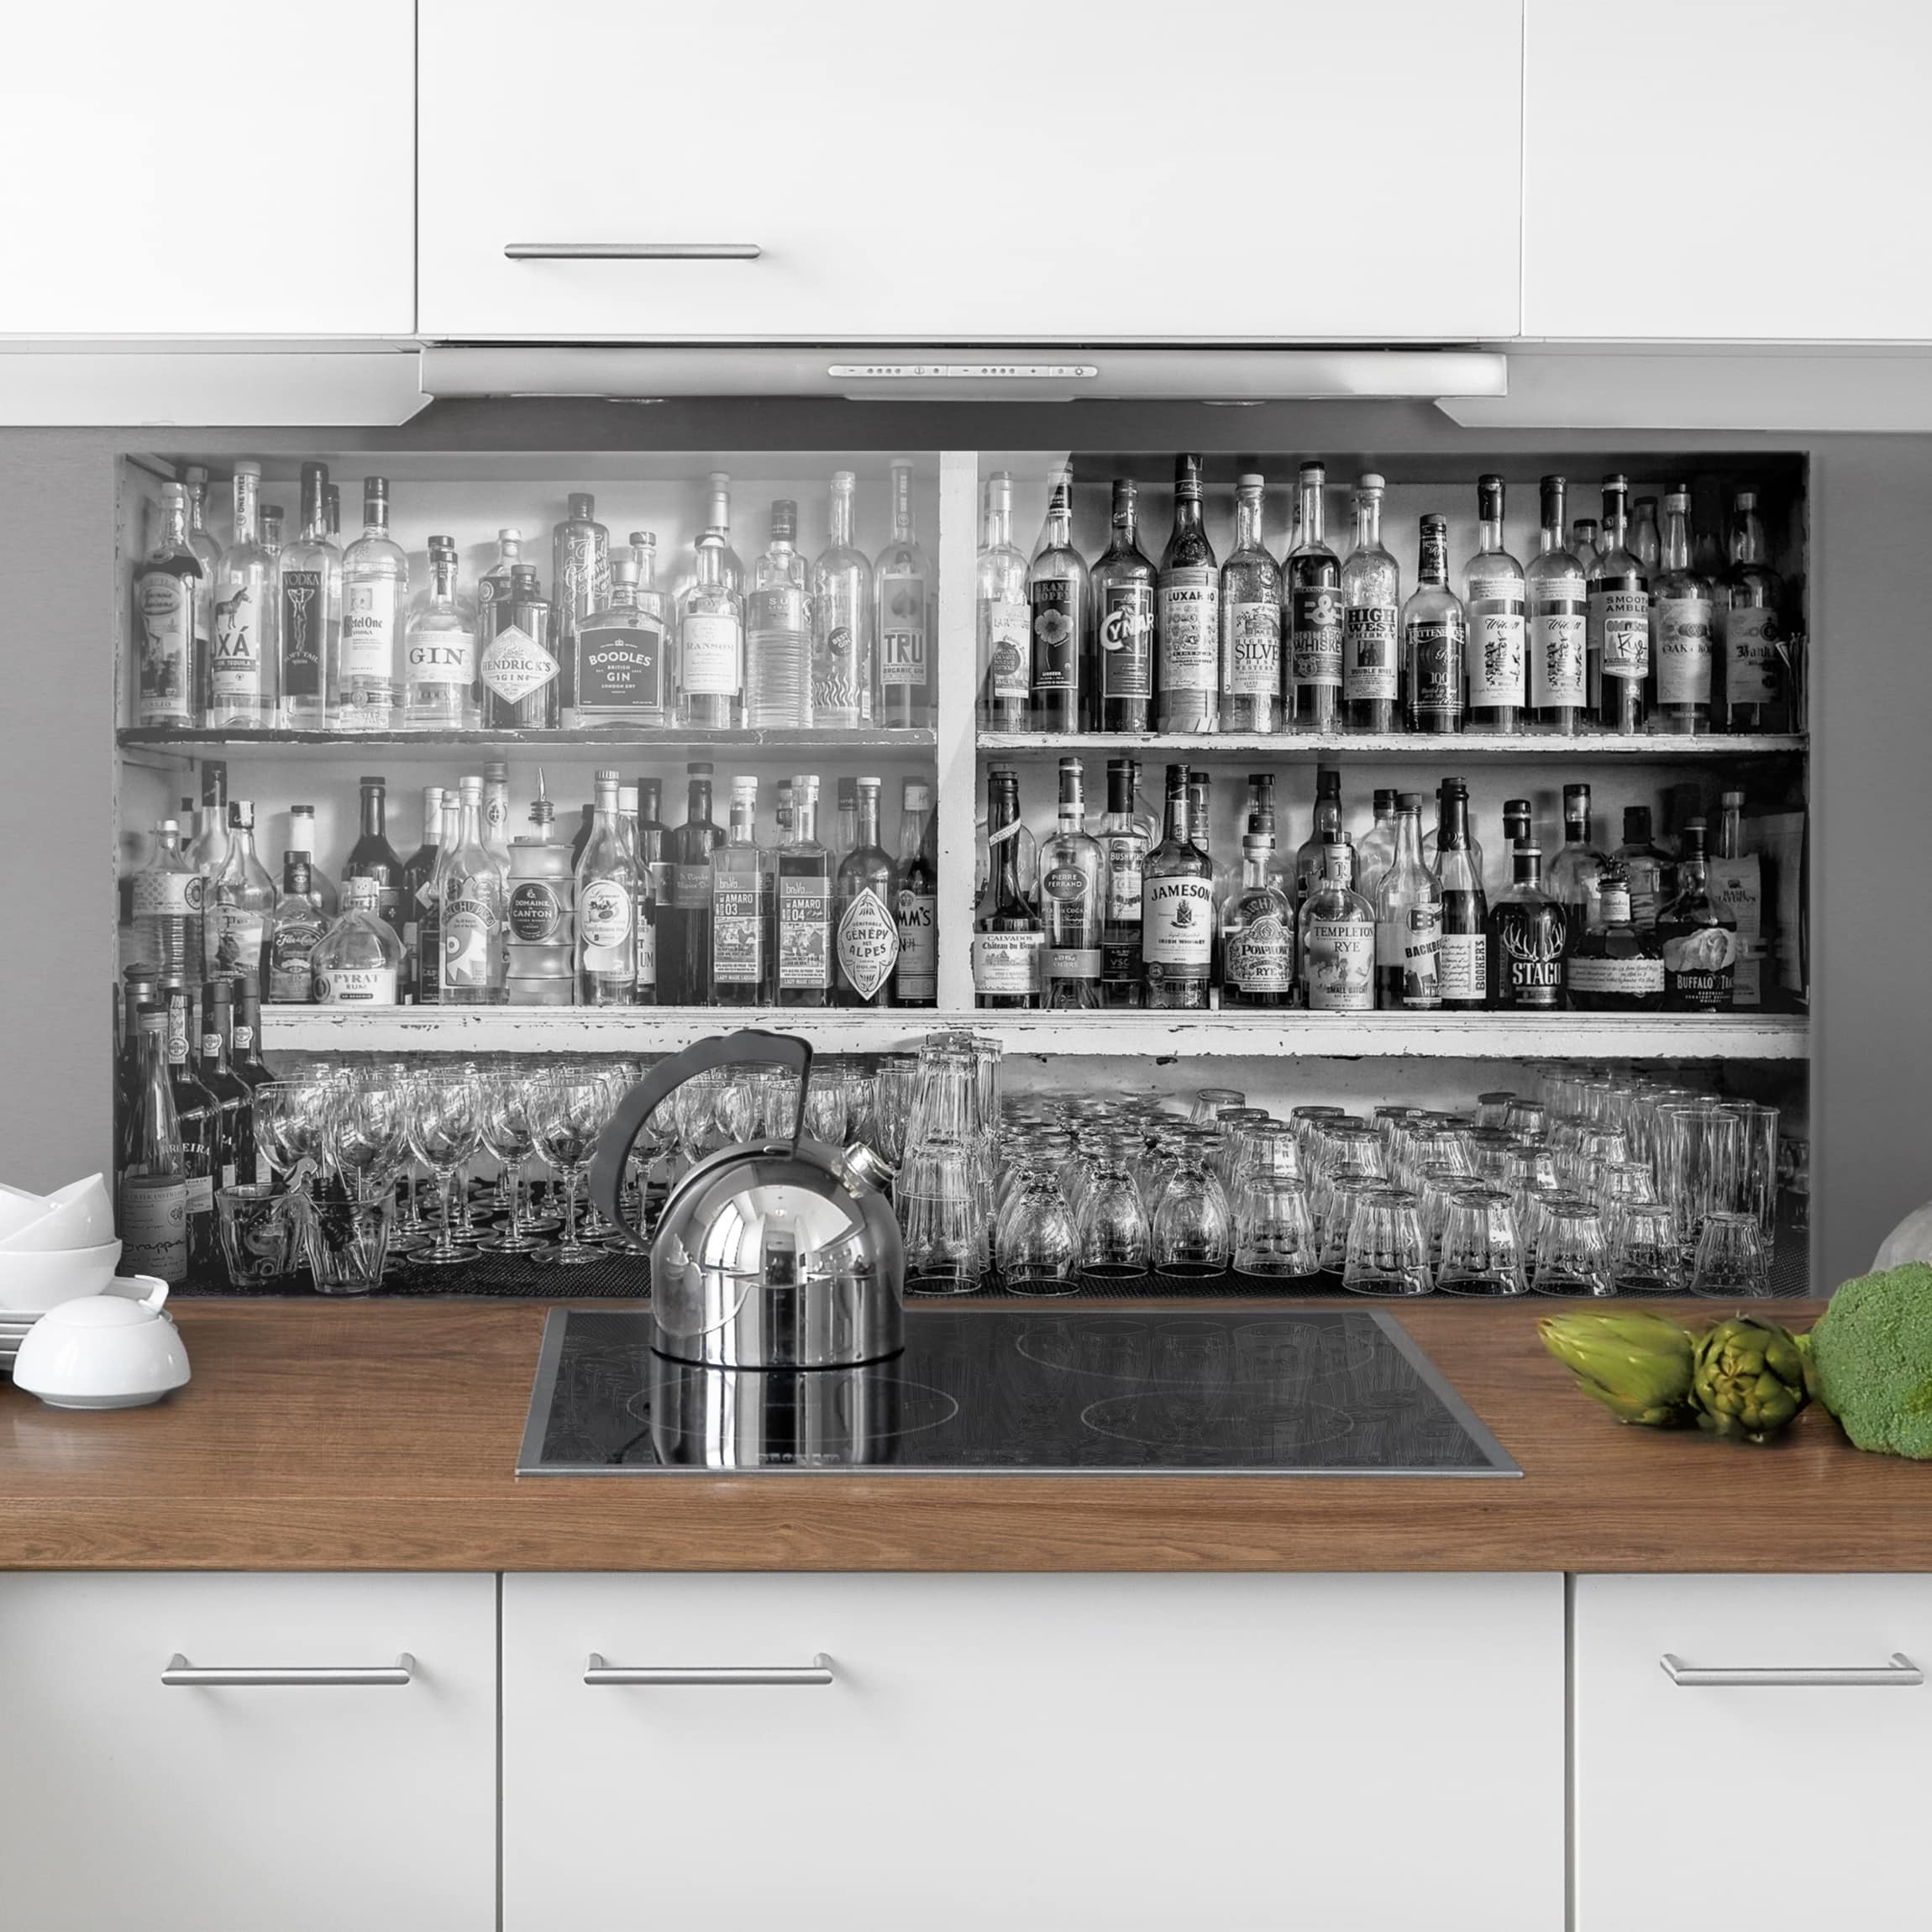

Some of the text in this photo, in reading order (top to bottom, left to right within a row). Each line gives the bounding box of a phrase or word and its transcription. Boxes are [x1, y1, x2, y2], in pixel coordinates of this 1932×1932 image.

[284, 573, 320, 585] VODKA
[884, 633, 923, 663] TRU
[409, 647, 466, 665] GIN
[589, 651, 652, 666] BOODLES
[606, 672, 630, 682] GIN
[1152, 884, 1210, 900] JAMESON
[725, 894, 753, 904] AMARO
[792, 899, 821, 909] AMARO
[512, 910, 552, 918] CANTON
[725, 904, 738, 916] 03
[792, 909, 805, 921] 04
[1315, 927, 1373, 937] TEMPLETON
[849, 943, 886, 958] ALPES
[1334, 941, 1361, 953] RYE
[1475, 940, 1485, 991] BOOKER'S
[334, 974, 378, 984] PYRAT
[1677, 974, 1713, 989] BUFFALO
